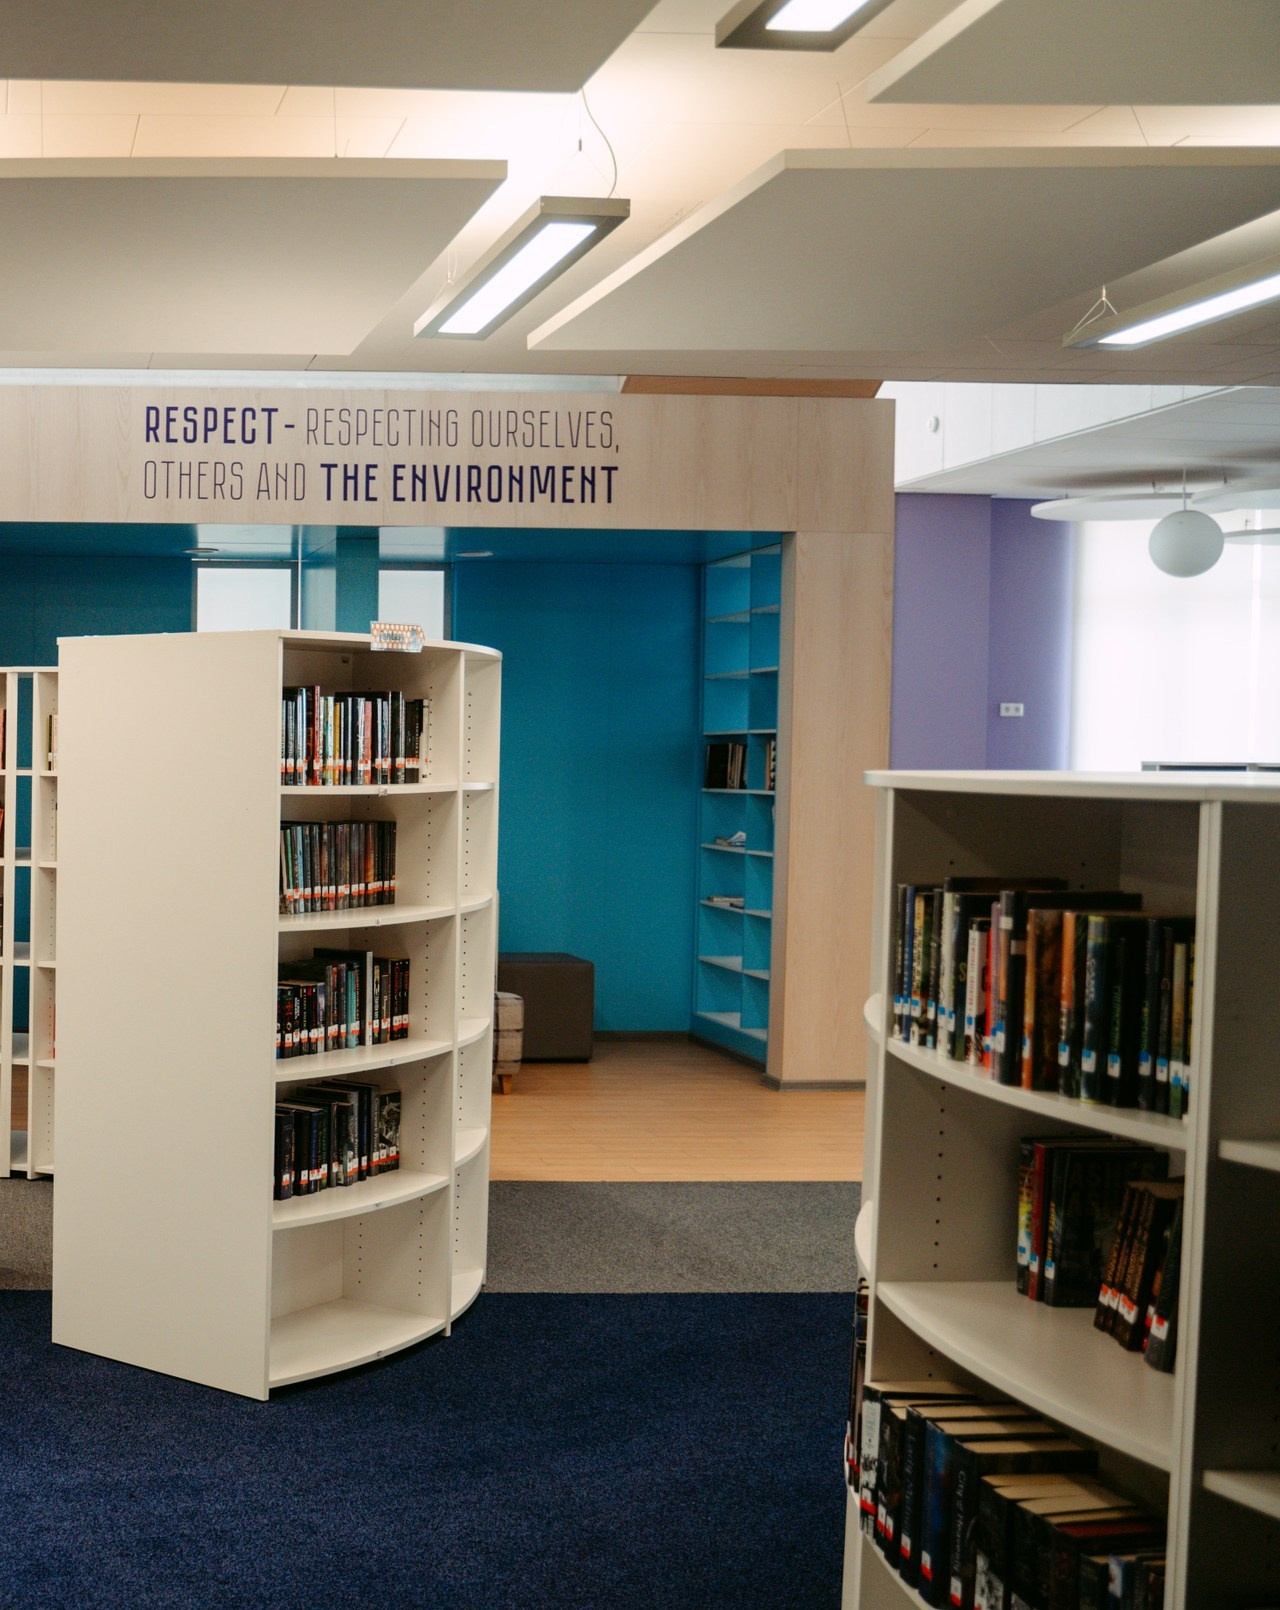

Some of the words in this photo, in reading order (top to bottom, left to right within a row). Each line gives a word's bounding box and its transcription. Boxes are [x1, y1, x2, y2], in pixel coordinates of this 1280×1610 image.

[306, 408, 459, 448] RESPECTING
[471, 409, 619, 454] OURSELVES,
[144, 460, 244, 500] OTHERS
[256, 462, 306, 501] AND
[320, 463, 378, 502] THE
[393, 464, 619, 504] ENVIRONMENT
